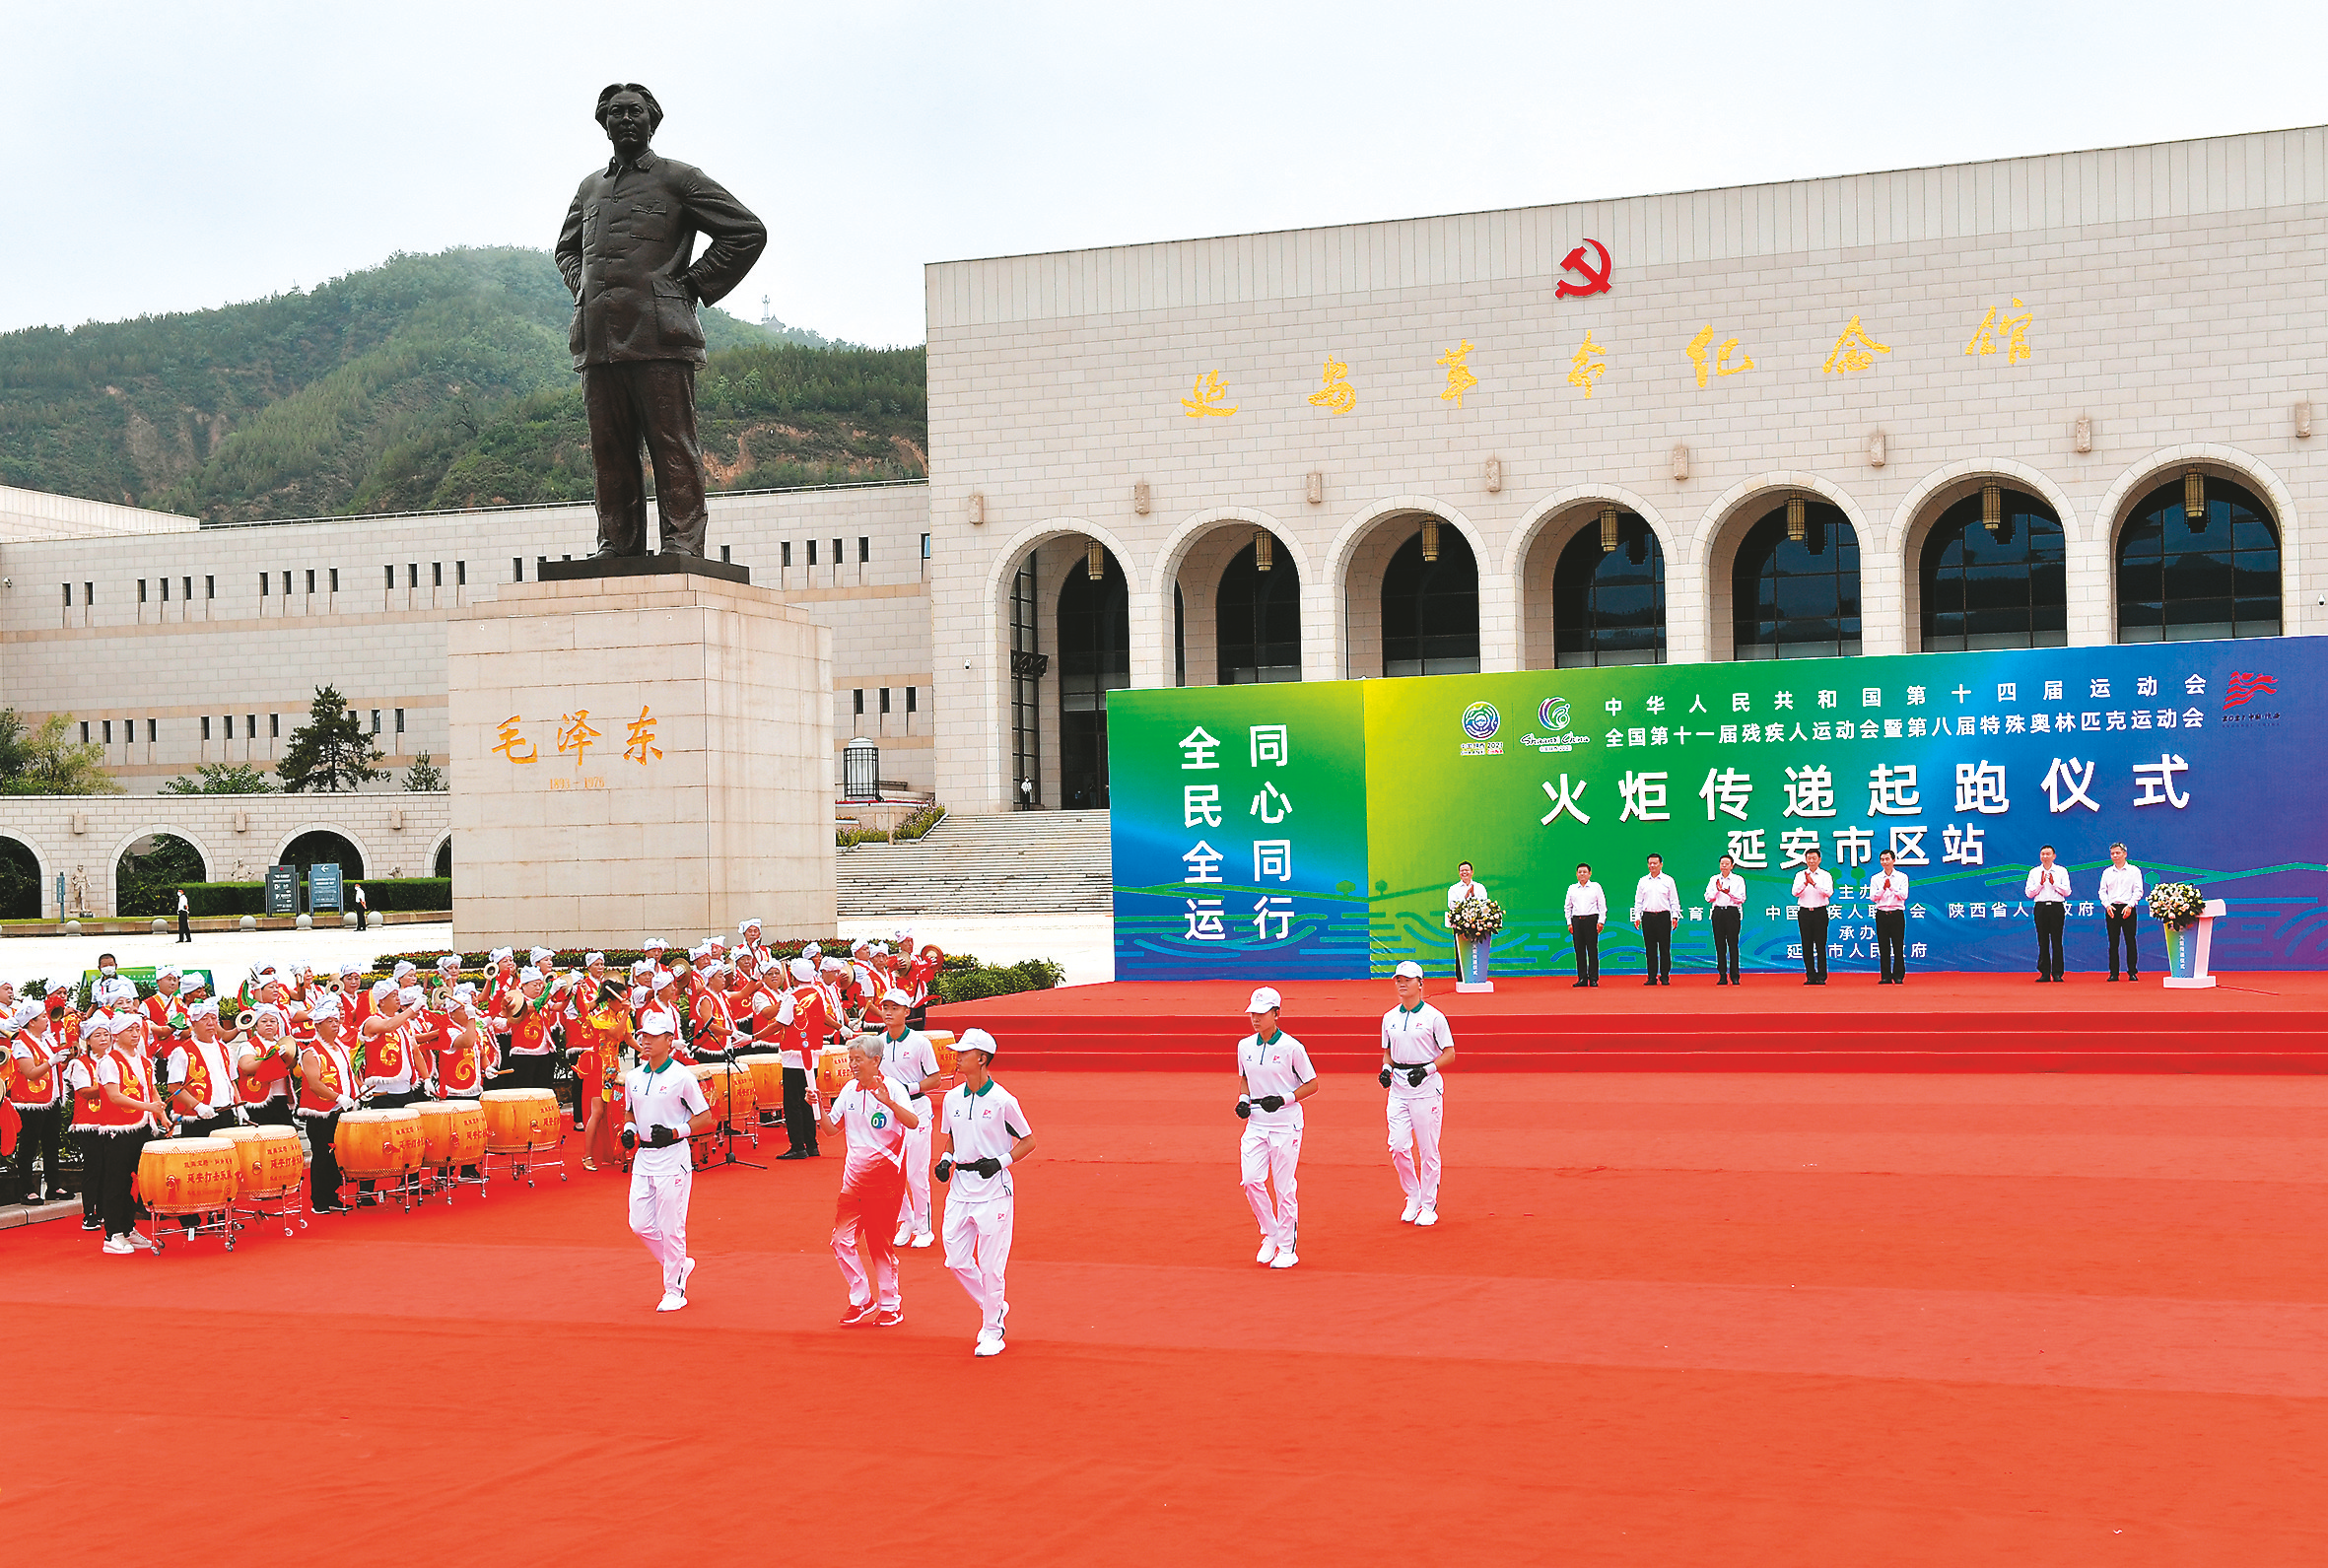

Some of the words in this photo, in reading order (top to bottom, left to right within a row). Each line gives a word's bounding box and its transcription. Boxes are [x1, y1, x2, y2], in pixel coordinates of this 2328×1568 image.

[1181, 298, 2033, 418] 延安革命纪念馆
[1605, 673, 2207, 716] 中华人民共和国第十四届运动会
[492, 706, 663, 767] 毛泽东
[1605, 706, 2205, 748] 全国第十一届残疾人运动会暨第八届特殊奥林匹克运动会
[1540, 753, 2191, 826] 火炬传递起跑仪式
[1179, 725, 1226, 940] 全民全运
[1249, 723, 1296, 939] 同心同行
[1727, 822, 1985, 870] 延安市区站
[1949, 901, 2094, 920] 陕西省人政府
[1786, 941, 1928, 959] 延市人民府
[872, 1117, 886, 1127] 01
